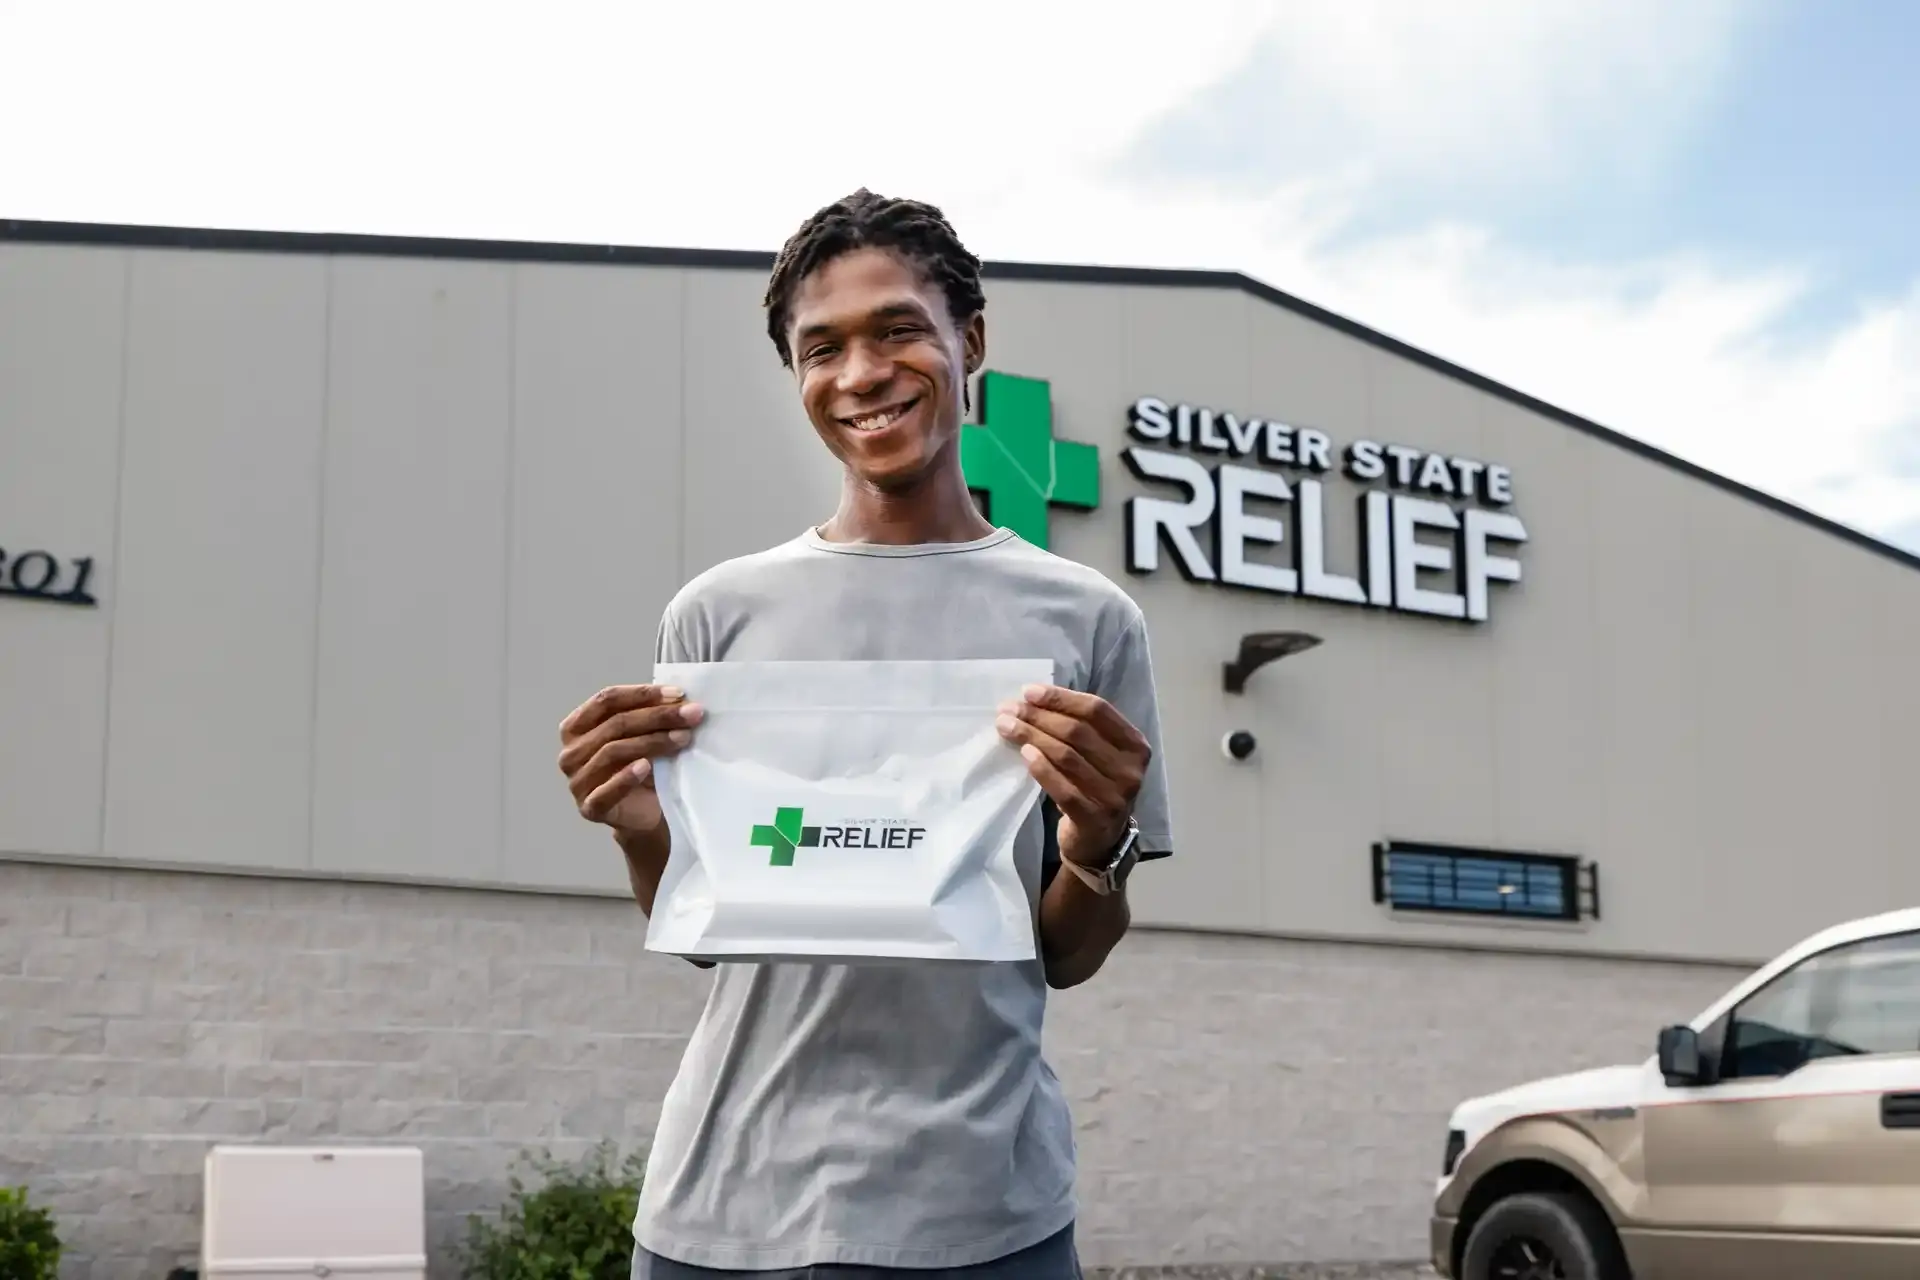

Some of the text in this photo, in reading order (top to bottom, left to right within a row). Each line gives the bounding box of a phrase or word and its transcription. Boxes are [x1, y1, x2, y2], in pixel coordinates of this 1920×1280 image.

[1131, 397, 1513, 502] SILVER STATE
[1127, 446, 1528, 622] RELIEF
[0, 546, 98, 606] 01
[823, 827, 926, 849] RELIEF
